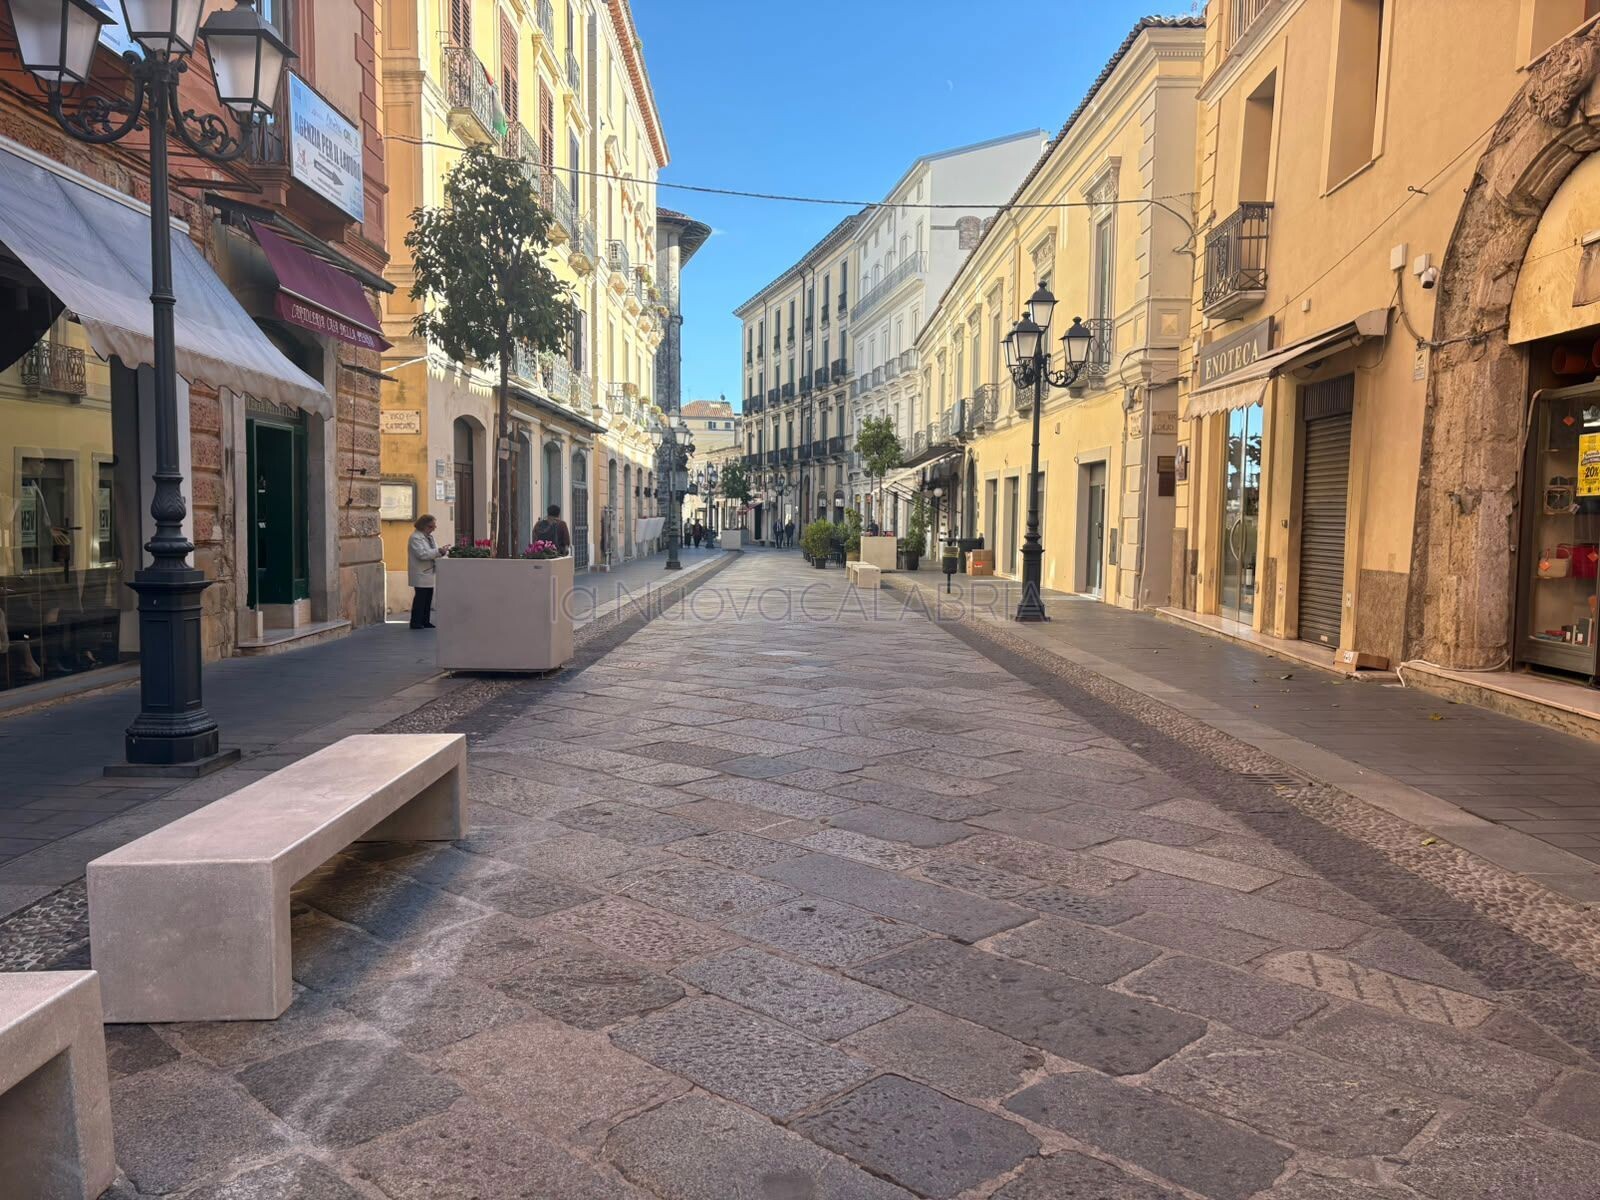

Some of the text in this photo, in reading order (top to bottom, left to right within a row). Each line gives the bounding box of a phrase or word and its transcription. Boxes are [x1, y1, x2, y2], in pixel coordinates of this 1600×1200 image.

[294, 111, 321, 151] AGENZIA
[321, 133, 334, 160] PER
[339, 147, 361, 183] LAVORO
[1205, 339, 1259, 380] ENOTECA
